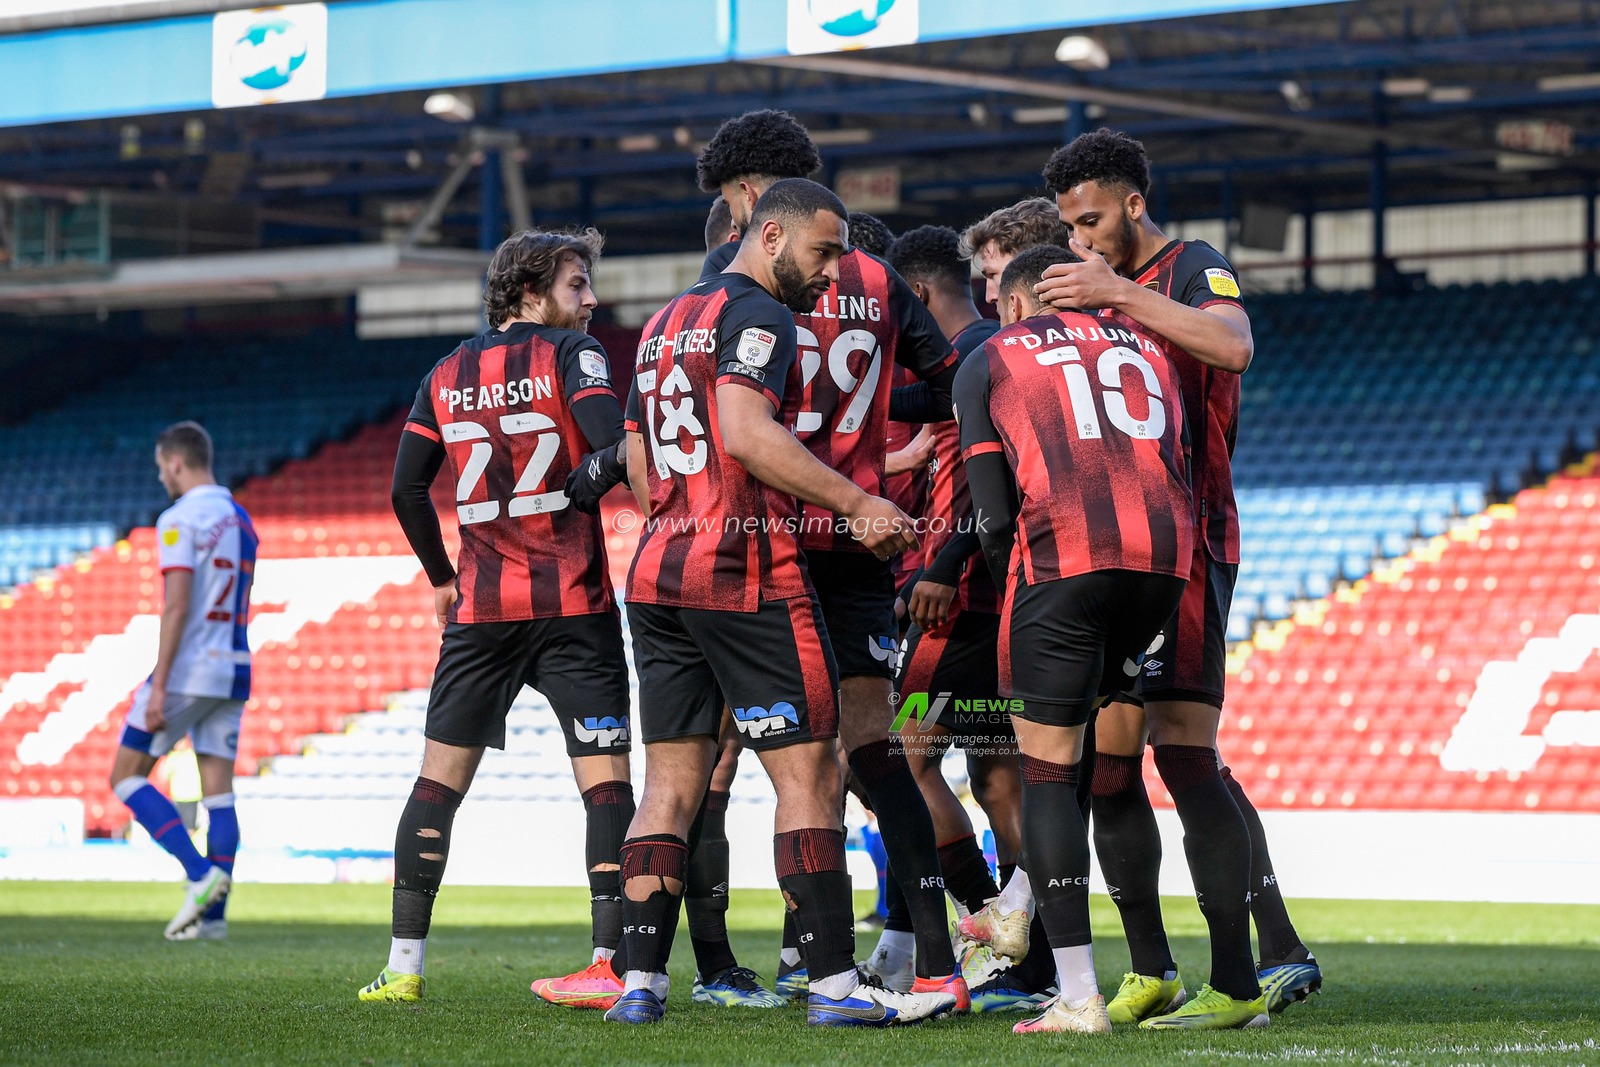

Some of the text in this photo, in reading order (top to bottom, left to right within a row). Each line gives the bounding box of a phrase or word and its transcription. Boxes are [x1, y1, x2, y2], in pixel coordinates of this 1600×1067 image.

[800, 294, 881, 322] LING
[1018, 326, 1161, 358] DANJUMA
[448, 375, 553, 413] PEARSON
[1035, 346, 1166, 440] 10
[637, 364, 708, 480] 18
[442, 412, 571, 525] 22
[764, 729, 786, 737] delivers
[1047, 876, 1089, 888] AFCB
[799, 932, 815, 944] CB
